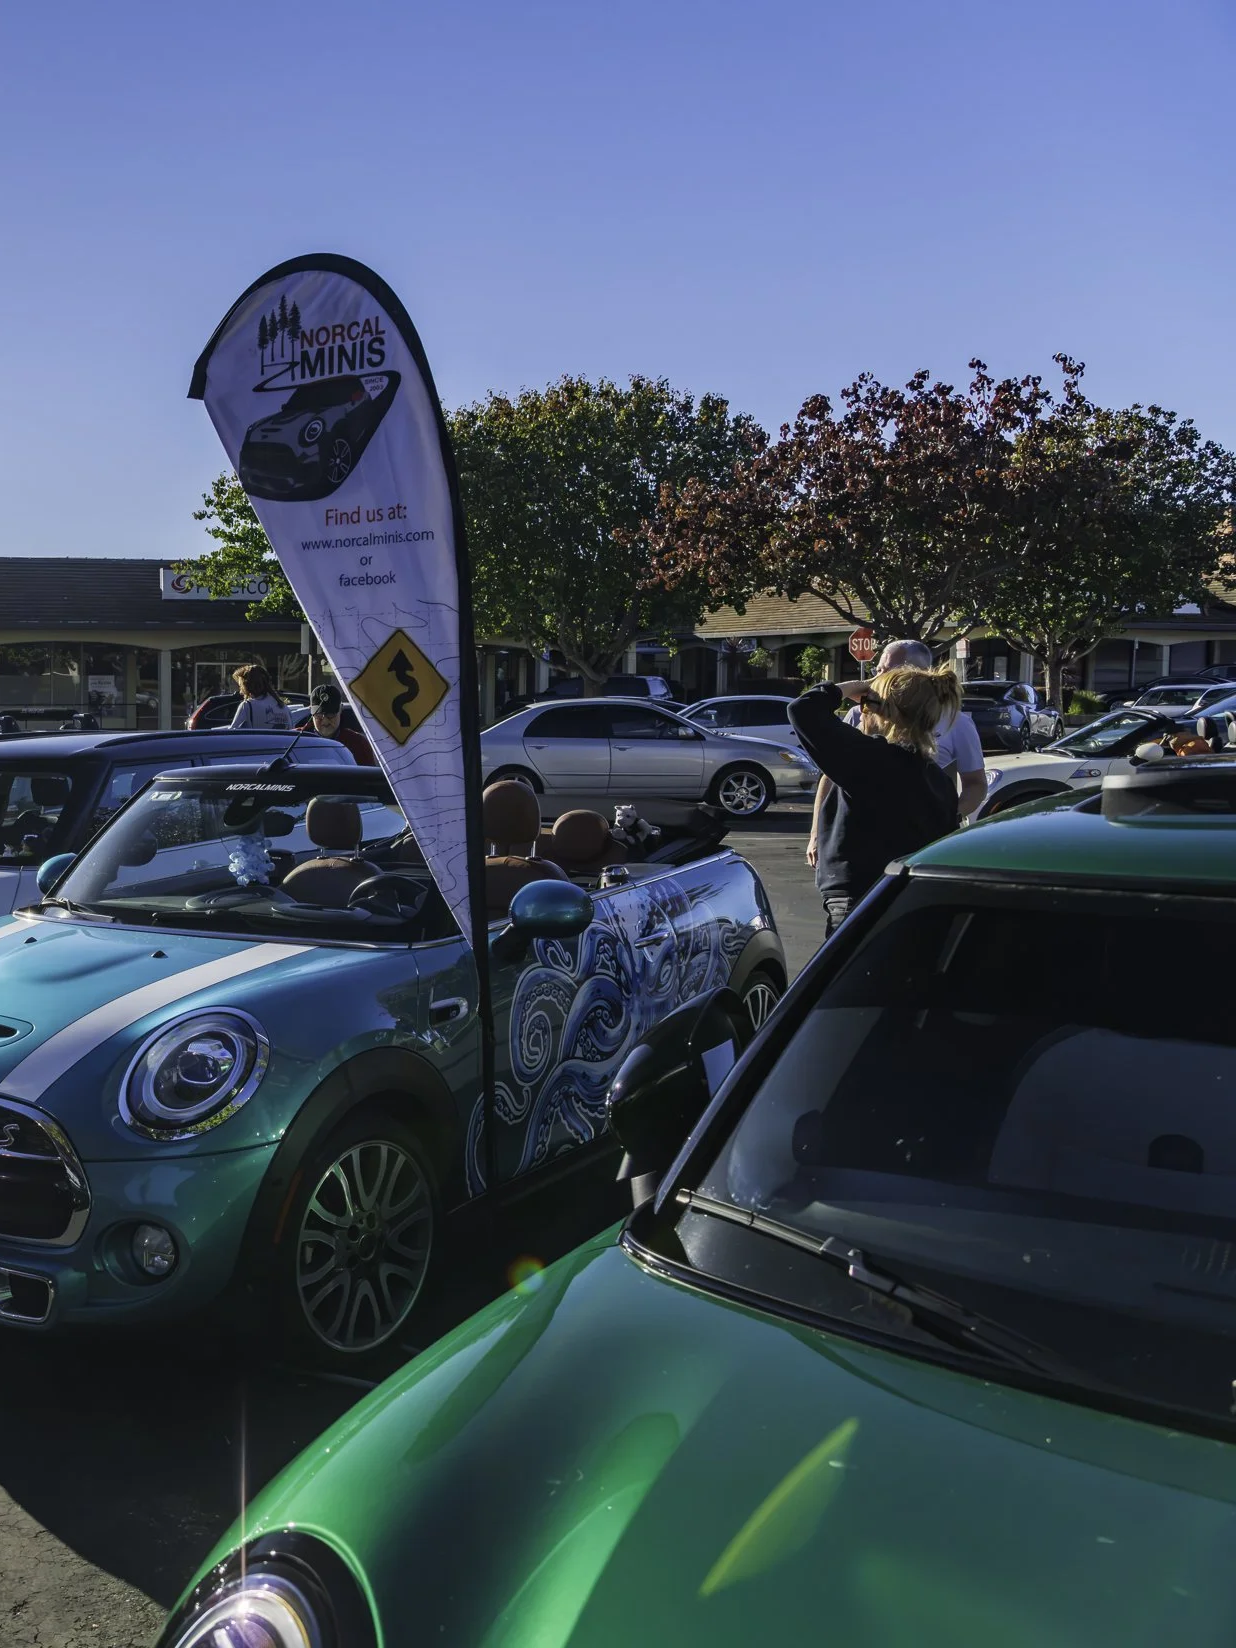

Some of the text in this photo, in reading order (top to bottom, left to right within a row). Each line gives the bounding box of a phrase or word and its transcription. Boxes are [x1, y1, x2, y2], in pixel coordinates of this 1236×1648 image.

[300, 316, 385, 349] NORCAL
[301, 337, 385, 379] MINIS
[365, 377, 384, 385] SINCE
[325, 503, 407, 526] Find us at:
[301, 530, 435, 551] www.norcalminis.com
[360, 556, 372, 566] or
[339, 571, 396, 587] facebook
[851, 638, 877, 651] STOP
[225, 783, 296, 792] NORCALMINIS
